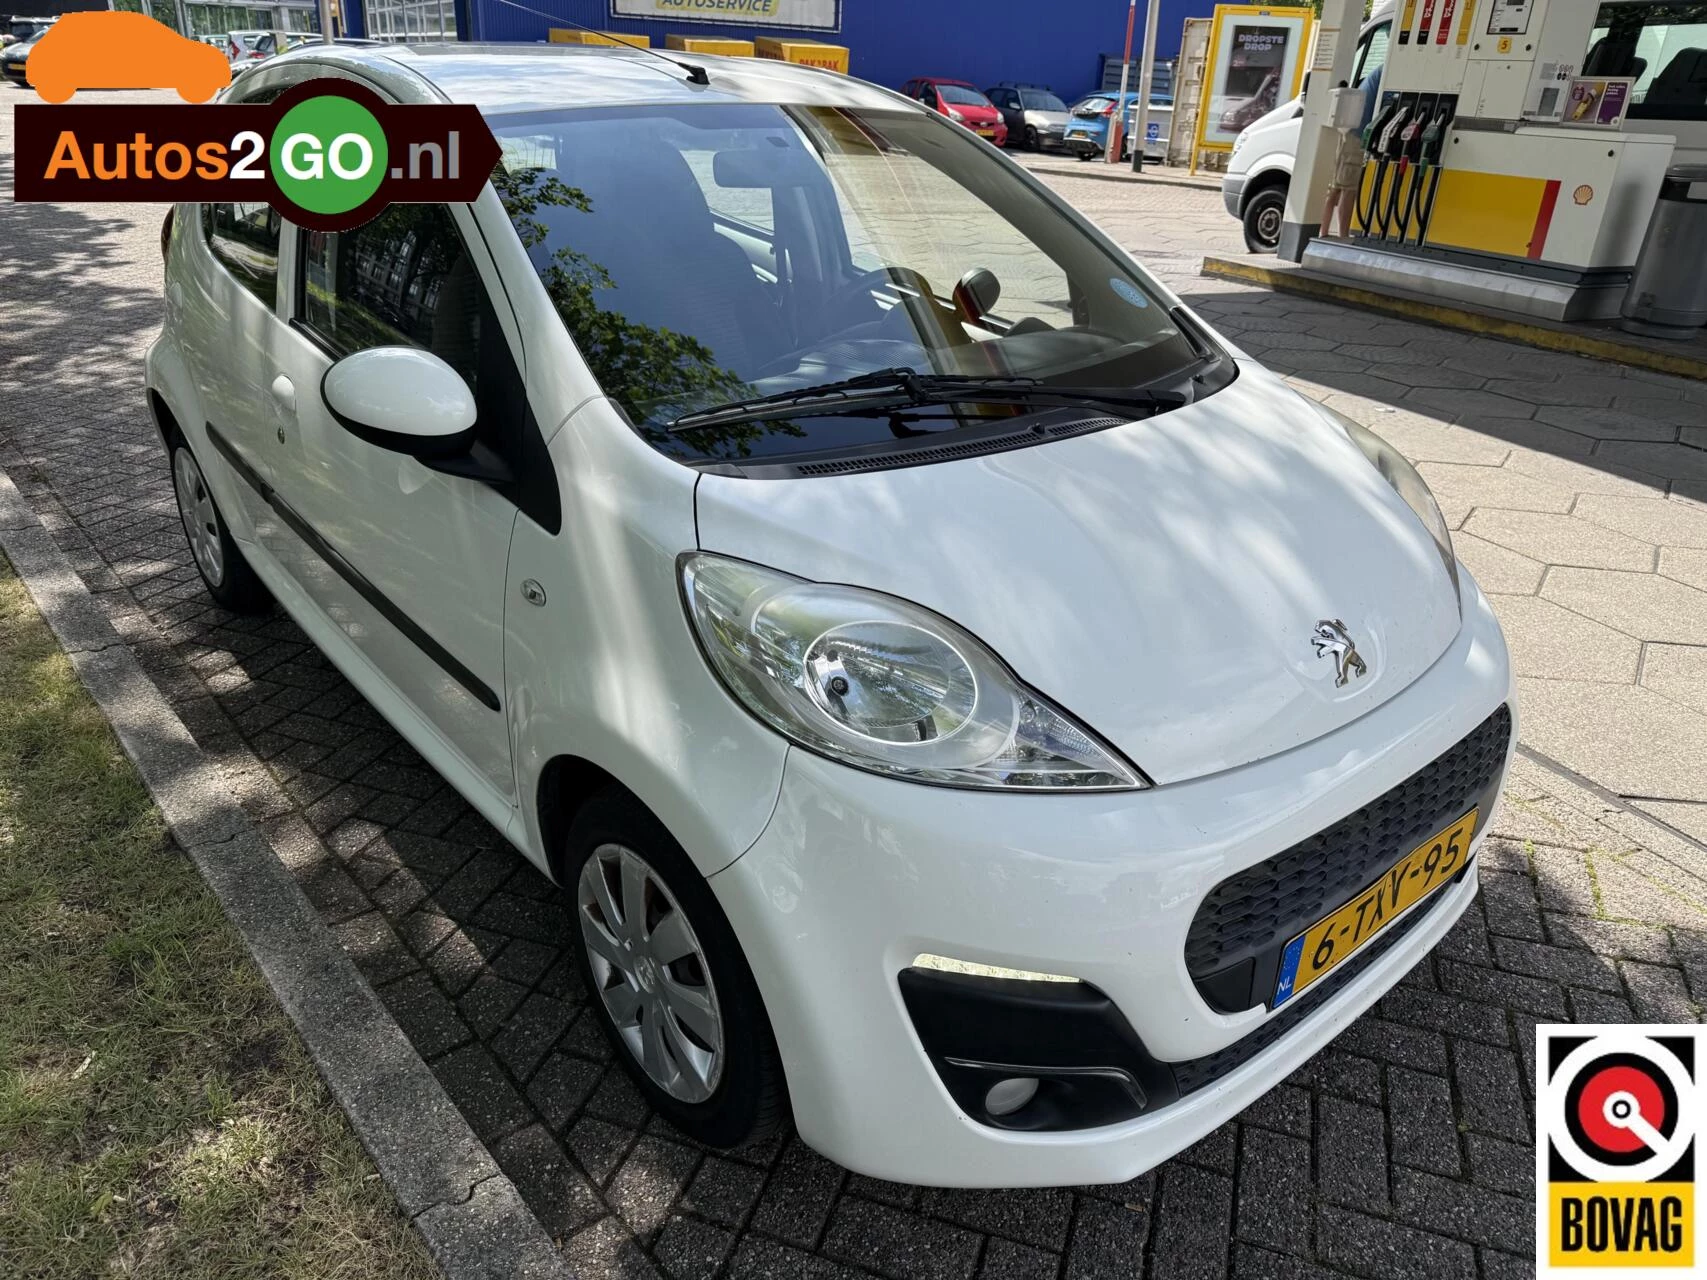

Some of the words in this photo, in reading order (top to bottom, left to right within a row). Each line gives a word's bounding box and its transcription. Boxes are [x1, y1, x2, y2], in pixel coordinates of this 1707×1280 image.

[1238, 33, 1285, 44] DROPSTE
[1244, 42, 1272, 52] DROP
[1312, 827, 1463, 971] 6-TXV-95
[1277, 976, 1292, 996] NL
